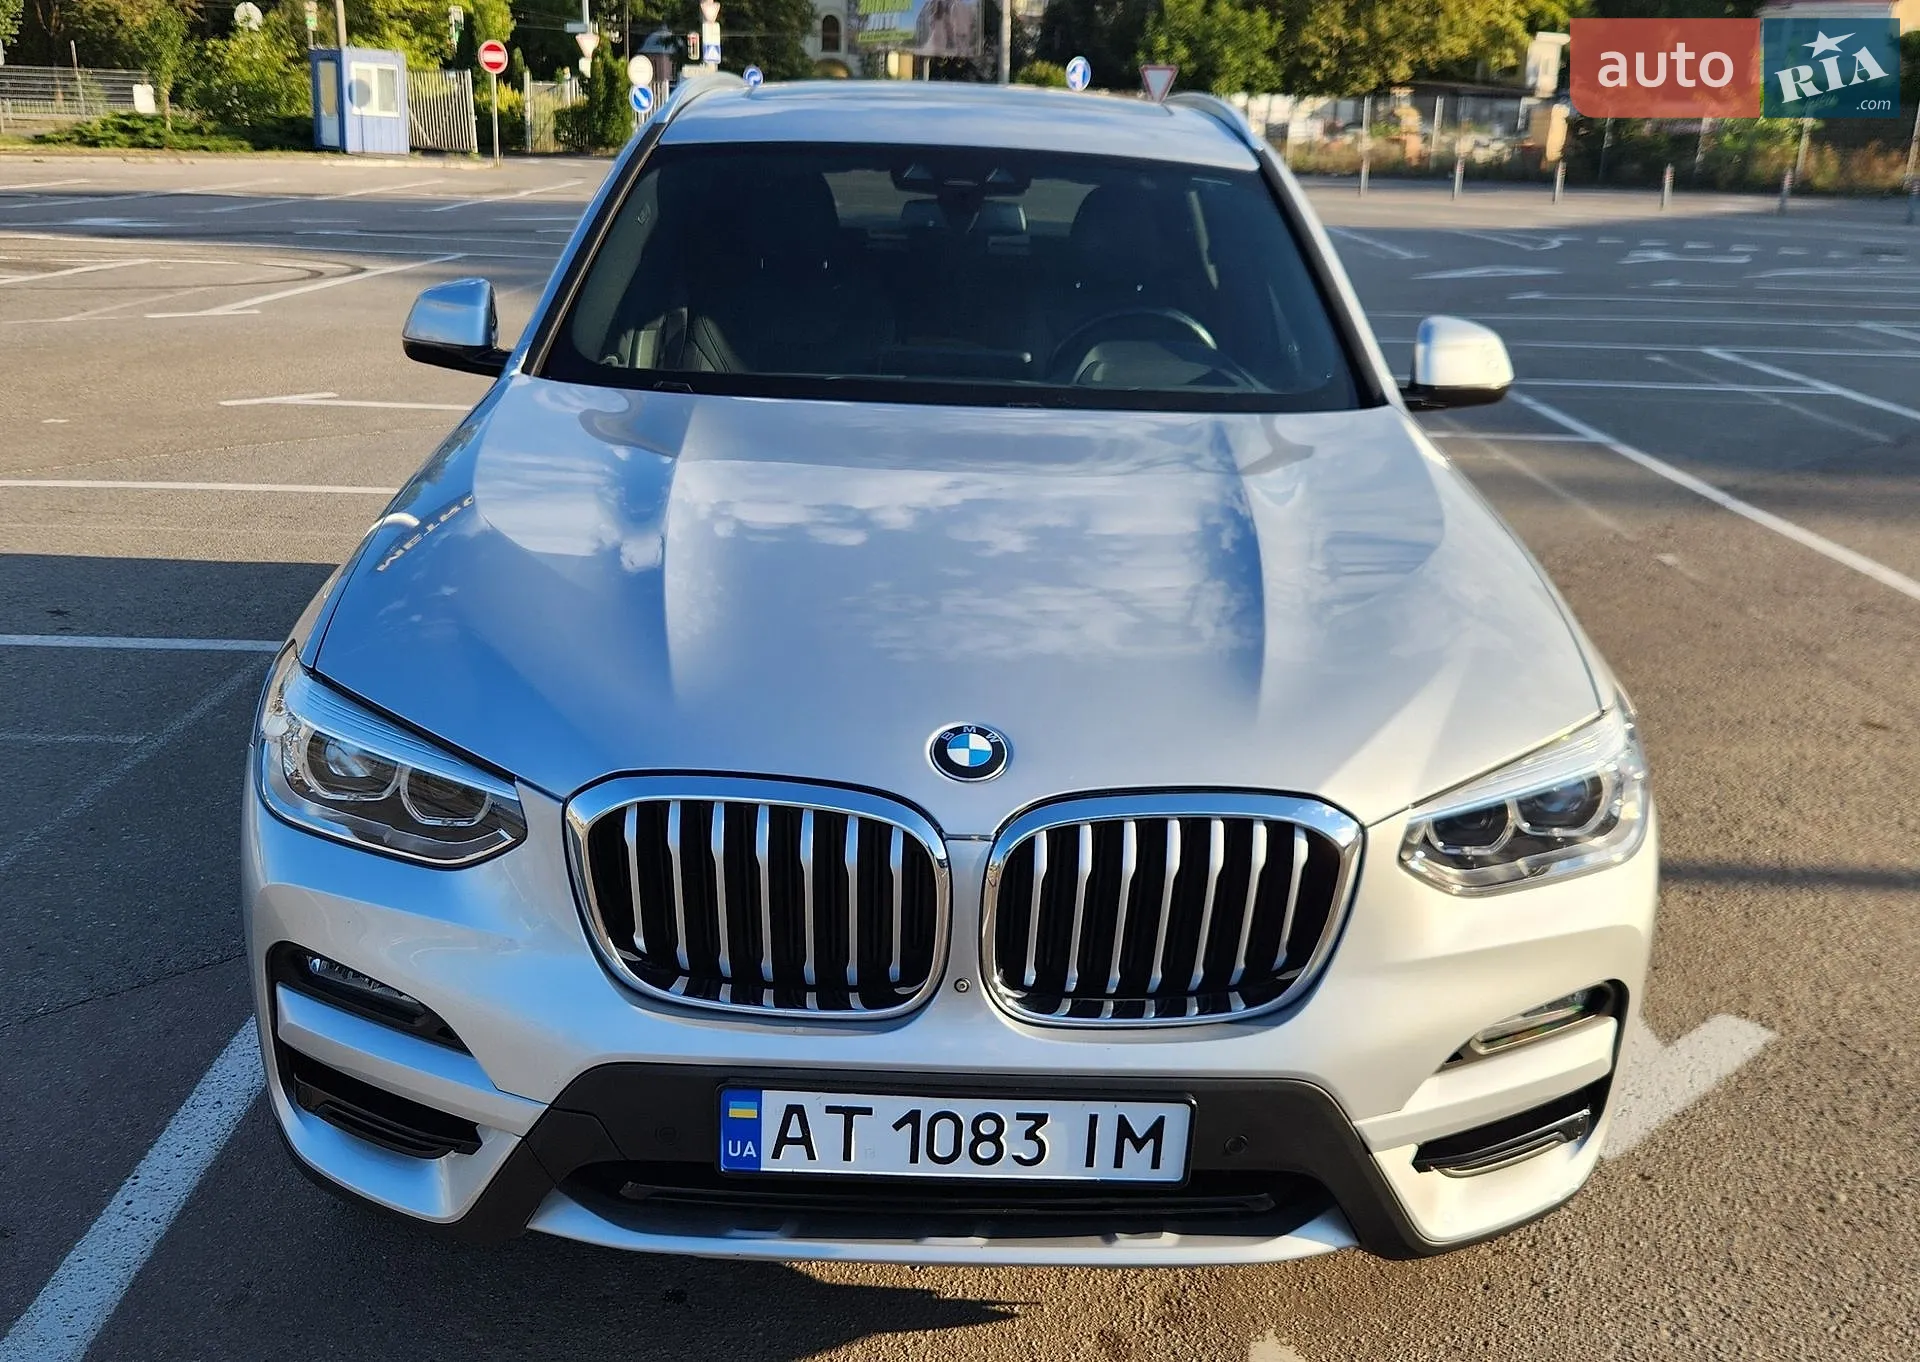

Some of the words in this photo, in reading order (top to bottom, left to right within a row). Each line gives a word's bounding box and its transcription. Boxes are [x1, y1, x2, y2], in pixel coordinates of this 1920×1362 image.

[941, 726, 1001, 744] BMW
[770, 1103, 875, 1163] AT
[891, 1108, 1051, 1168] 1083
[1084, 1112, 1167, 1170] IM
[728, 1140, 757, 1159] UA
